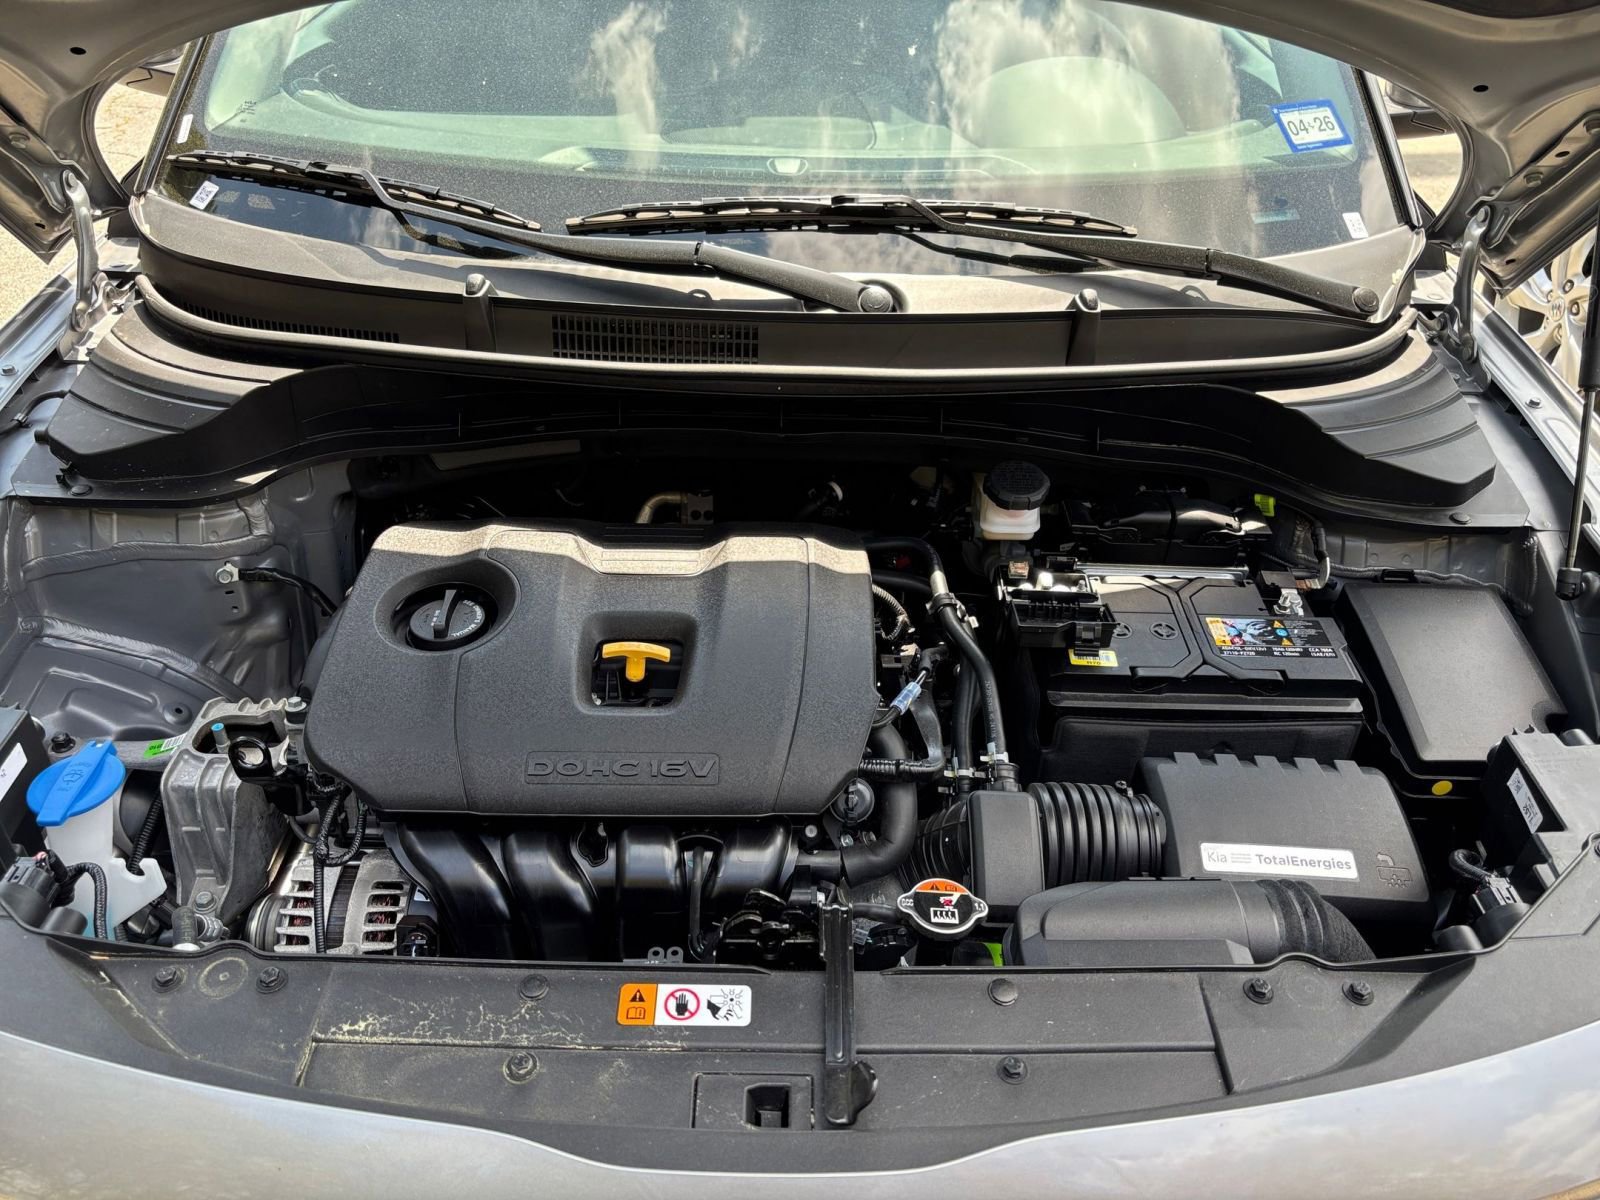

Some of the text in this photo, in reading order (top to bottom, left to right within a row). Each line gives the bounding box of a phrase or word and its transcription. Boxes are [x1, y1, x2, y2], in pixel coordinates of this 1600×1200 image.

[1287, 115, 1335, 136] 04 26
[527, 758, 717, 778] DOHC 16V
[1207, 851, 1352, 870] Kia TotalEnergies
[974, 902, 985, 911] 1.1
